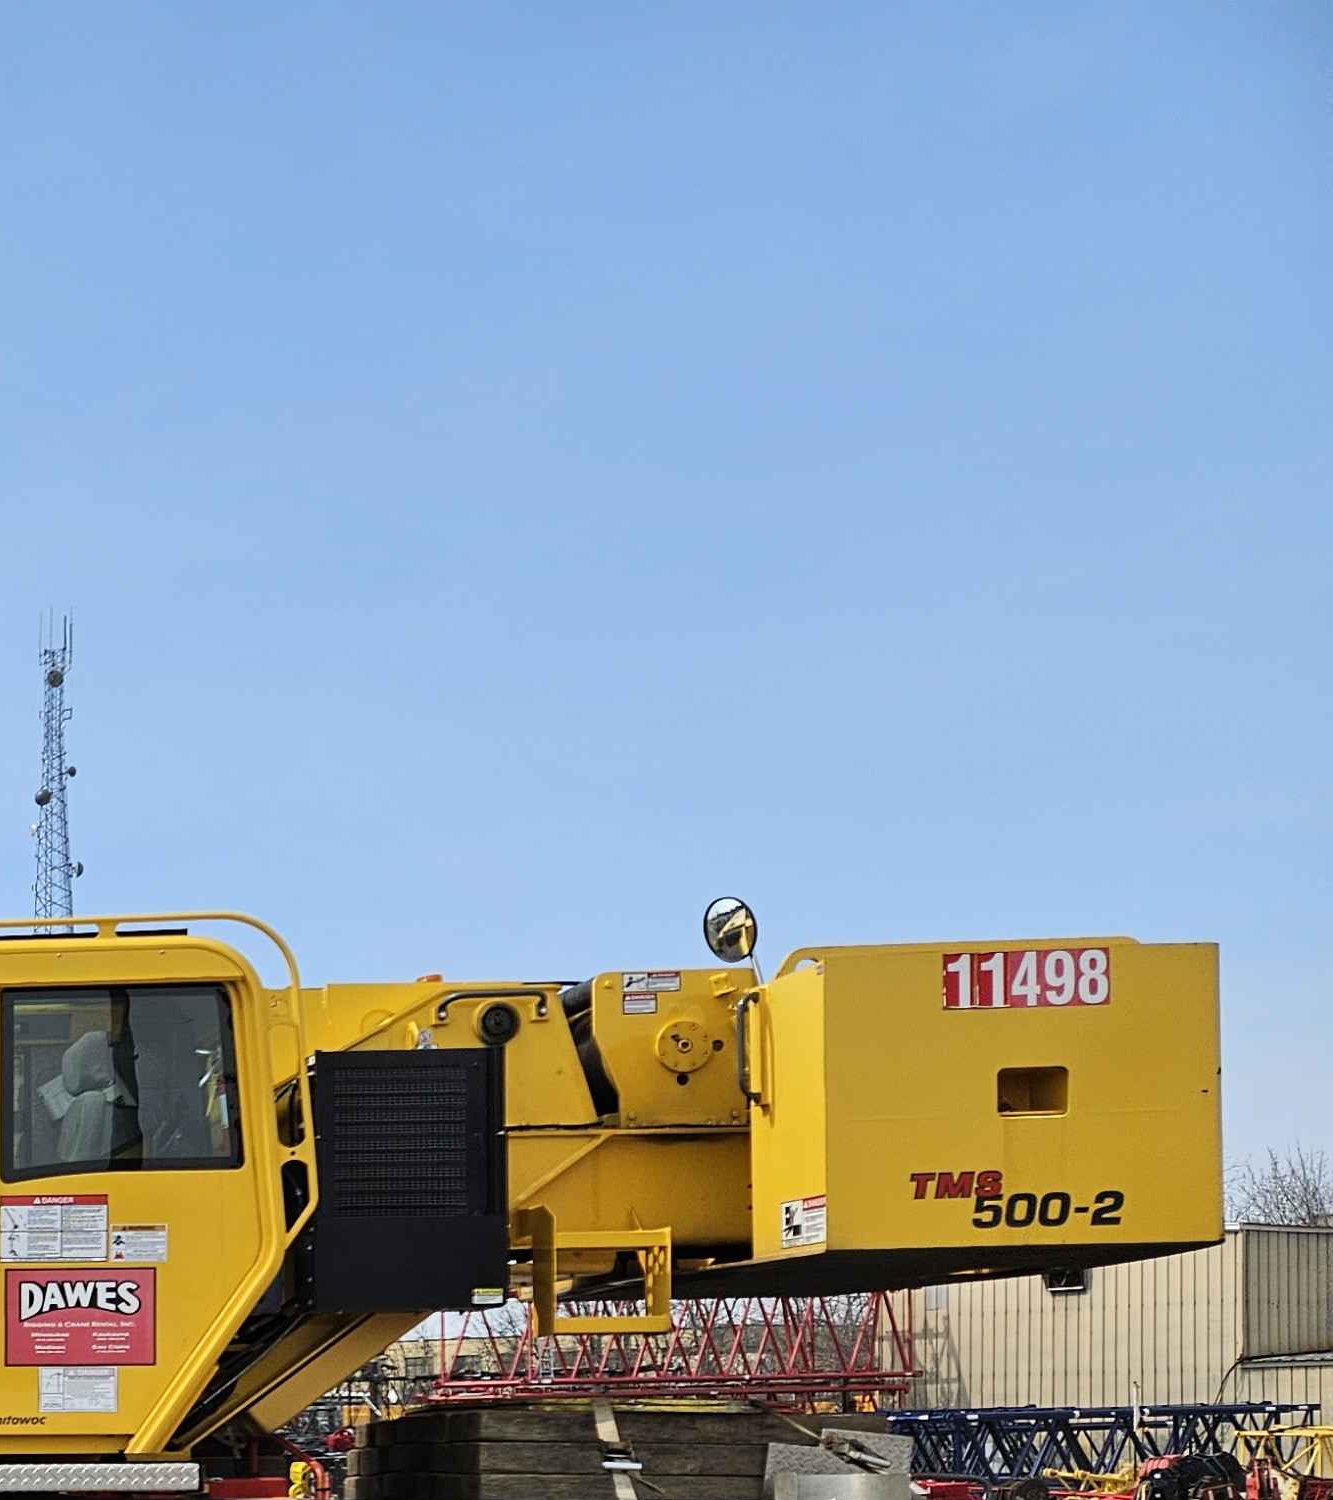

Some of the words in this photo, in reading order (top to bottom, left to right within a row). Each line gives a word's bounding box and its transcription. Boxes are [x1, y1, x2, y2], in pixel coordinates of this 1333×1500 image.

[947, 949, 1109, 1008] 11498
[910, 1170, 1003, 1200] TMS
[972, 1190, 1125, 1229] 500-2
[20, 1280, 142, 1322] DAWES
